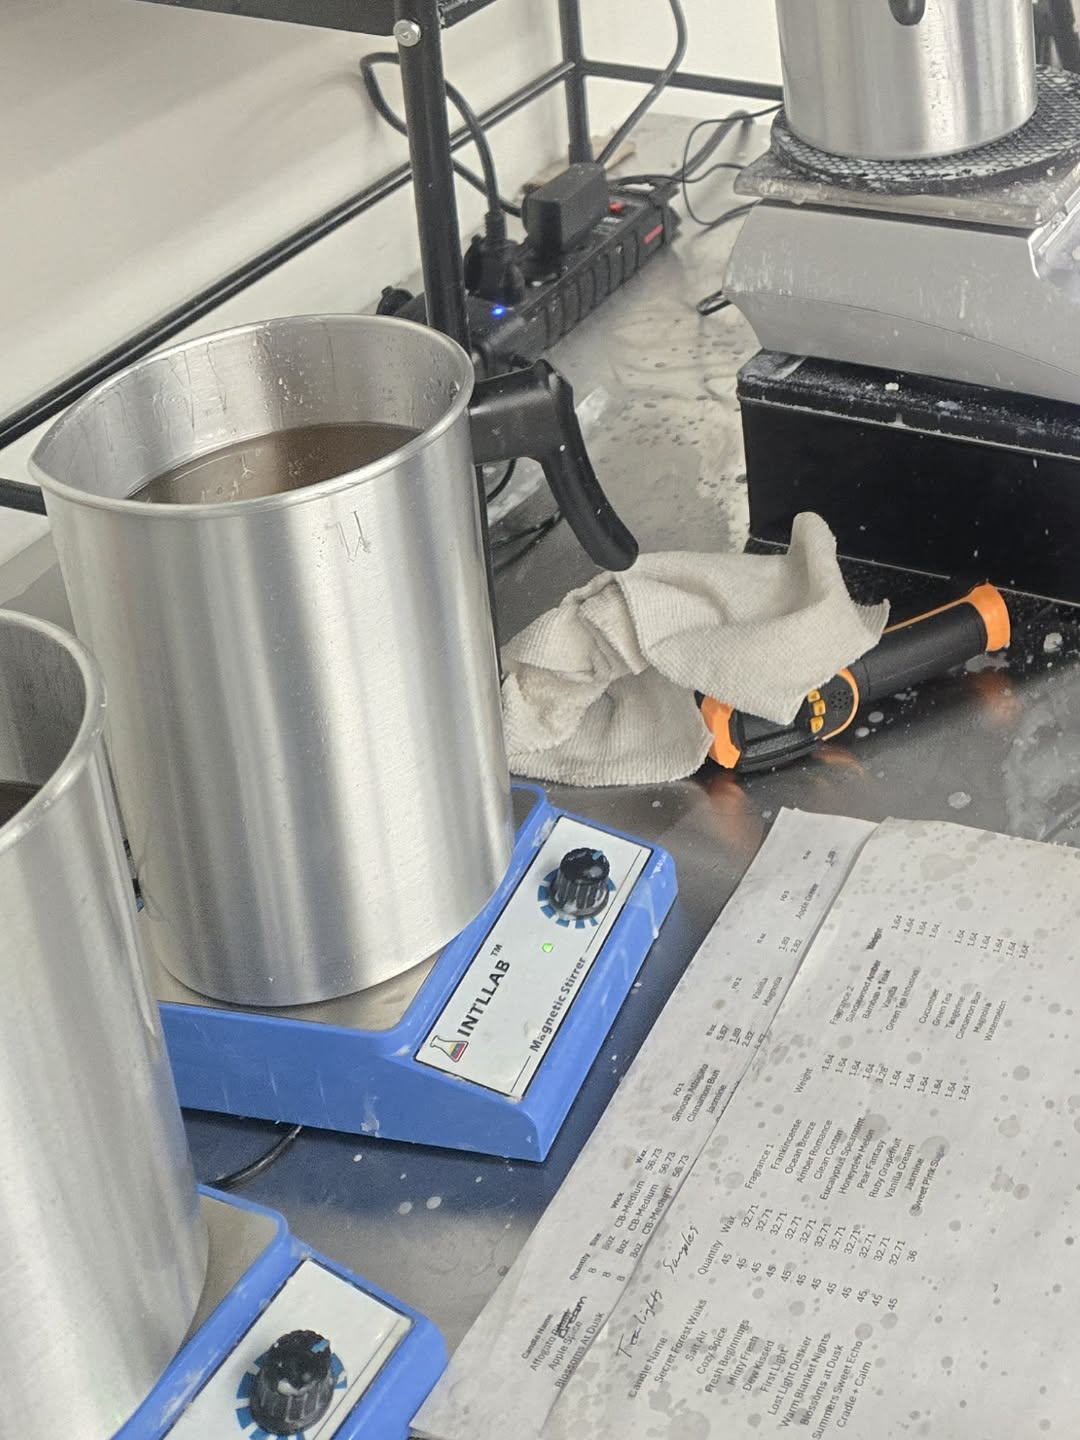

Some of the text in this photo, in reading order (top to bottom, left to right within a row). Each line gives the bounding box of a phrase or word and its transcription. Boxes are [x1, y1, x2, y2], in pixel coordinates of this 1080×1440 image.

[979, 934, 991, 949] 1.64
[992, 938, 1003, 953] 1.64
[457, 959, 511, 1038] INTLLAB
[529, 956, 588, 1054] Magnetic Stirrer
[828, 991, 851, 1025] Fragrance
[885, 1009, 901, 1030] Green
[895, 996, 907, 1009] Tea
[918, 988, 939, 1024] Cucumber
[931, 992, 952, 1026] Green Tea
[944, 996, 965, 1028] Tangerine
[954, 990, 981, 1039] Cinnamon Bun
[972, 1002, 992, 1033] Magnolia
[983, 1000, 1006, 1041] Watermelon
[821, 1053, 834, 1070] 1.64
[874, 1064, 888, 1084] 3.28
[793, 1067, 813, 1093] Weight
[888, 1069, 902, 1086] 1.64
[902, 1073, 915, 1089] 1.64
[958, 1084, 971, 1100] 1.64
[671, 1093, 692, 1122] Smooth
[686, 1069, 720, 1122] Cinnamon Bun
[706, 1084, 727, 1114] Jasmine
[769, 1118, 801, 1169] Frankincense
[784, 1121, 816, 1174] Ocean Breeze
[796, 1119, 832, 1183] Amber Romance
[813, 1129, 843, 1179] Clean Cotton
[819, 1116, 866, 1200] Eucalyptus Spearmint
[644, 1147, 662, 1170] 56.73
[658, 1151, 676, 1174] 56.73
[671, 1154, 689, 1177] 56.73
[743, 1149, 770, 1189] Fragrance
[838, 1128, 874, 1194] Honeydew Melon
[856, 1140, 886, 1189] Pear Fantasy
[868, 1137, 902, 1198] Ruby Grapefruit
[884, 1143, 915, 1198] Vanilla Cream
[904, 1157, 924, 1190] Jasmine
[613, 1180, 645, 1228] CB-Medium
[910, 1185, 928, 1212] Sweet
[921, 1167, 936, 1185] Pink
[627, 1183, 658, 1231] CB-Medium
[641, 1184, 672, 1234] CB-Medium
[740, 1204, 759, 1227] 32.71
[754, 1208, 773, 1231] 32.71
[720, 1215, 736, 1232] Wax
[769, 1212, 787, 1235] 32.71
[784, 1215, 802, 1239] 32.71
[798, 1219, 817, 1243] 32.71
[813, 1222, 831, 1247] 32.71
[828, 1226, 846, 1250] 32.71
[614, 1238, 629, 1254] 8oz
[629, 1242, 643, 1258] 8oz
[843, 1226, 861, 1254] 32.71
[858, 1233, 876, 1258] 32.71
[872, 1236, 890, 1261] 32.71
[888, 1240, 905, 1265] 32.71
[568, 1252, 590, 1280] Quantity
[587, 1266, 597, 1274] 8
[697, 1239, 723, 1275] Quantity
[720, 1253, 732, 1264] 45
[735, 1257, 747, 1269] 45
[750, 1261, 761, 1273] 45
[906, 1249, 917, 1262] 36
[601, 1270, 611, 1278] 8
[615, 1274, 625, 1282] 8
[765, 1264, 776, 1277] 45
[780, 1269, 792, 1282] 45
[795, 1273, 807, 1286] 45
[810, 1277, 822, 1290] 45
[825, 1282, 837, 1295] 45
[840, 1286, 852, 1299] 45
[856, 1290, 868, 1303] 45
[871, 1293, 883, 1306] 45
[887, 1297, 898, 1310] 45
[521, 1313, 553, 1359] Candle Name
[653, 1299, 707, 1384] Secret Forest Walks
[684, 1329, 707, 1362] Salt Air
[695, 1327, 727, 1374] Cozy Spice
[529, 1336, 555, 1371] Affogato
[547, 1345, 568, 1370] Apple
[554, 1312, 604, 1390] Blossoms At Dusk
[704, 1319, 749, 1393] Fresh Beginnings
[726, 1335, 760, 1386] Minty Fresh
[741, 1339, 775, 1391] Dew Kissed
[627, 1337, 668, 1398] Candle Name
[758, 1345, 788, 1392] First Light
[766, 1335, 811, 1415] Lost Light Duskier
[778, 1332, 830, 1427] Warm Blanket Nights
[799, 1344, 843, 1425] Blossoms at Dusk
[812, 1340, 863, 1436] Summers Sweet Echo
[836, 1395, 856, 1427] Cradle
[854, 1361, 871, 1386] Calm
